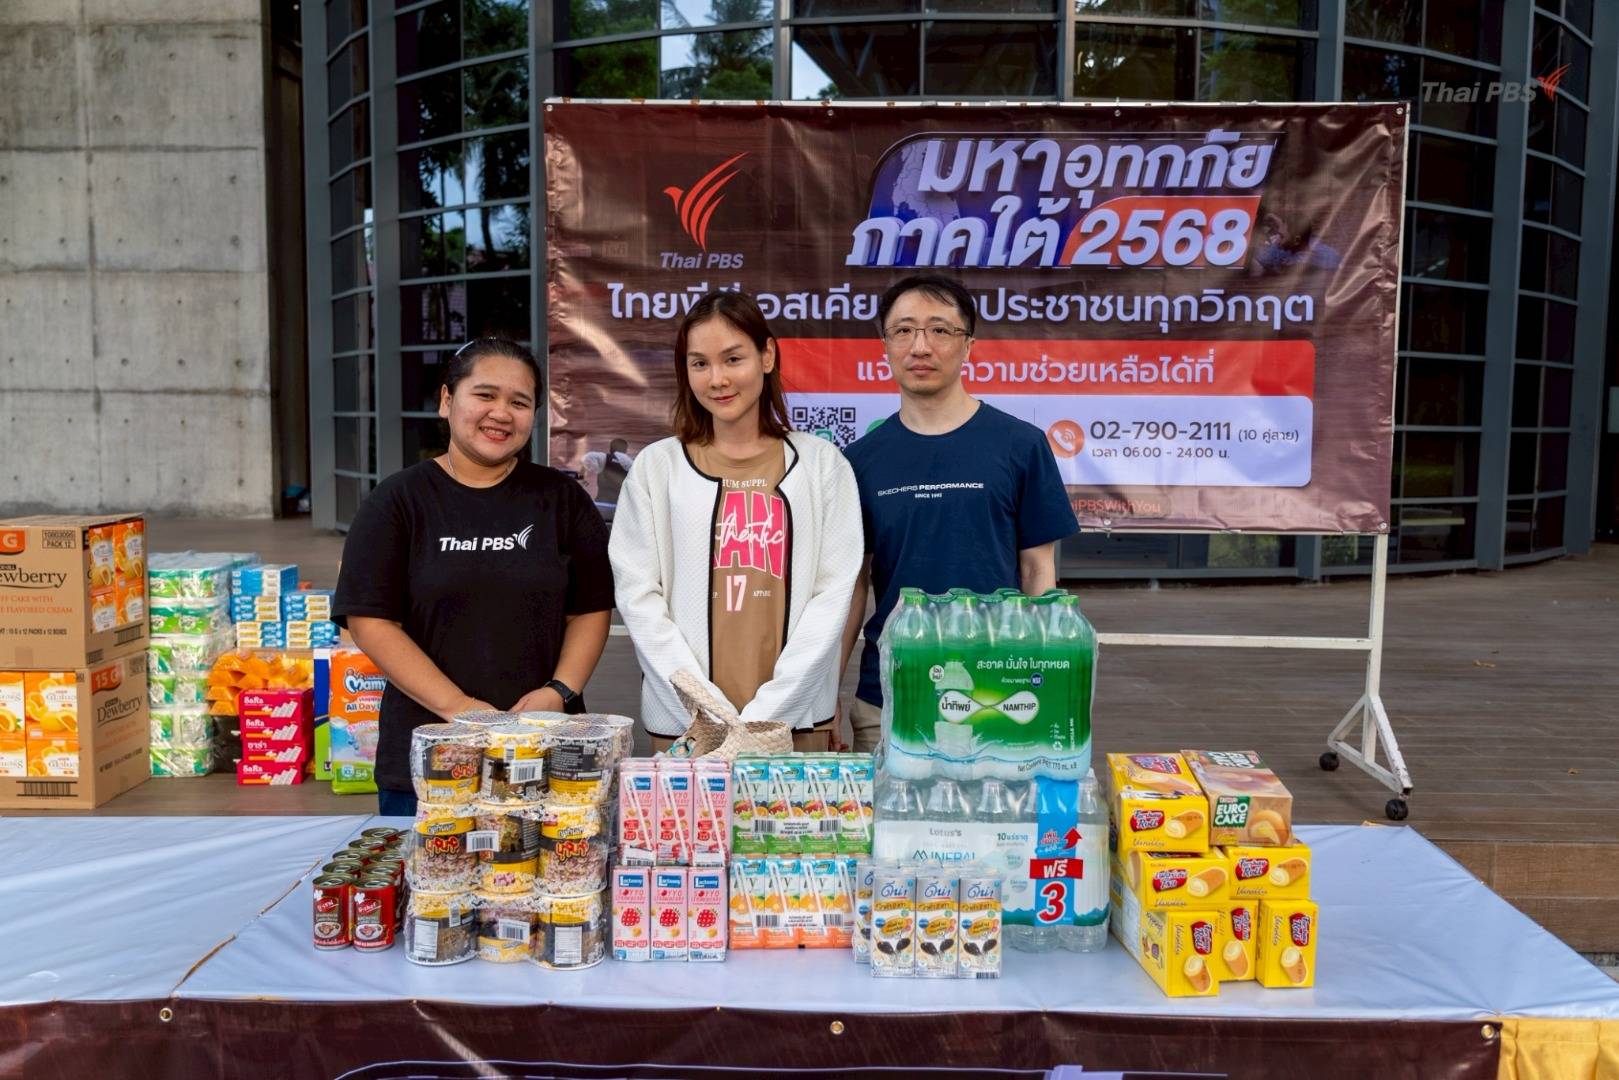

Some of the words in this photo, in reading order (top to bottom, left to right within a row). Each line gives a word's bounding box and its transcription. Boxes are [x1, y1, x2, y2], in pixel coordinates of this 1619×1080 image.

[918, 129, 1277, 207] มหาอุทกภัย
[845, 195, 1068, 267] ภาคใต้
[1073, 208, 1250, 267] 2568
[660, 252, 702, 269] Thai
[706, 252, 744, 269] PBS
[1089, 420, 1231, 441] 02-790-2111
[1238, 429, 1257, 442] (10
[1262, 429, 1299, 445] คู่สาย)
[1092, 447, 1118, 458] เวลา
[1122, 446, 1161, 458] 06.00
[1176, 447, 1213, 458] 24.00
[1219, 449, 1230, 458] น.
[878, 485, 918, 497] SKECHERS
[919, 483, 984, 491] PERFORMANCE
[2, 533, 18, 548] G
[439, 537, 478, 552] Thai
[481, 537, 515, 551] PBS
[0, 567, 68, 589] ewberry
[726, 574, 747, 612] 17
[977, 660, 1003, 669] สะอาด
[1006, 655, 1027, 670] มั่นใจ
[1030, 658, 1070, 672] ในทุกหยด
[95, 673, 108, 687] 15
[97, 696, 142, 722] Dewberry
[347, 703, 357, 711] All
[359, 703, 375, 712] Day
[942, 697, 971, 712] น้ำทิพย์
[1003, 703, 1036, 712] NAMTHIP
[1216, 802, 1248, 815] EURO
[1214, 813, 1246, 825] CAKE
[929, 828, 962, 837] Lotus's
[1043, 859, 1068, 878] ฟรี
[880, 880, 908, 898] ดีน่า
[924, 880, 951, 898] ดีน่า
[967, 882, 994, 899] ดีน่า
[1037, 880, 1067, 923] 3
